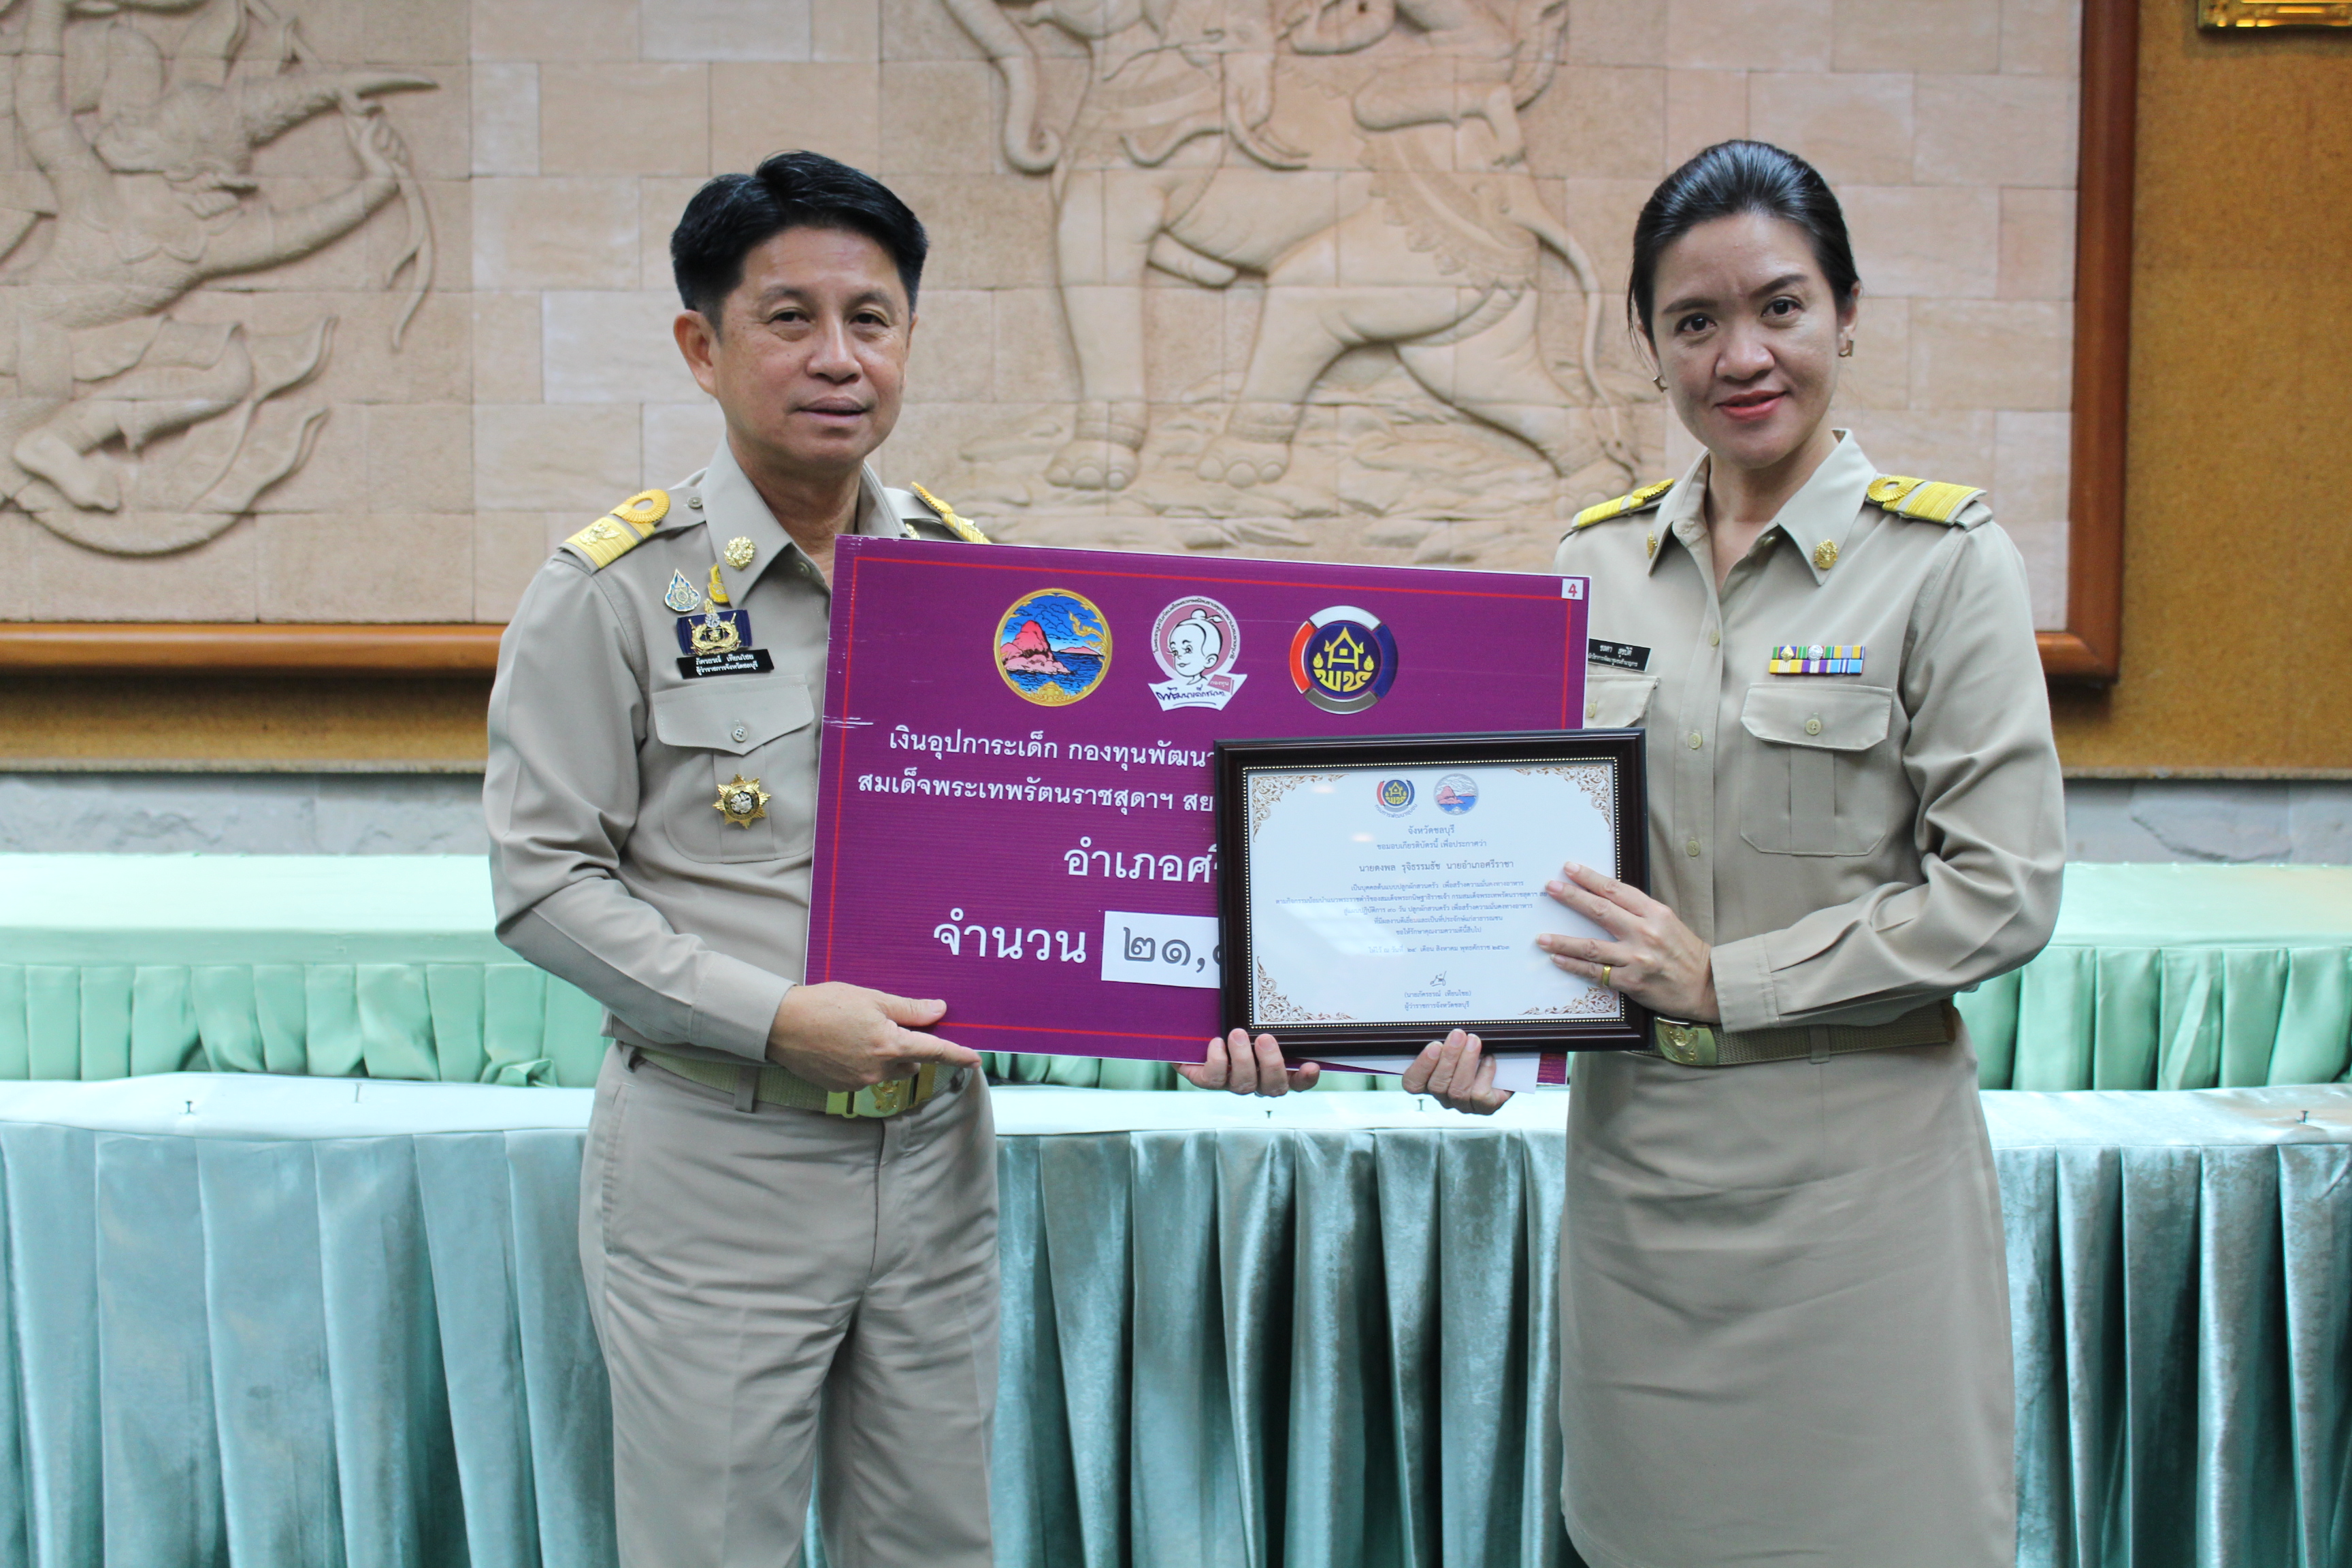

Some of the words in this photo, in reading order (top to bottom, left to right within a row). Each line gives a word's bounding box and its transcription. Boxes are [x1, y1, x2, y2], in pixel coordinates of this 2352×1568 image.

[1567, 583, 1578, 598] 4
[889, 725, 1058, 760] เงินอุปการะเด็ก
[858, 767, 1173, 815] สมเด็จพระเทพรัตนราชสุดาฯ
[1407, 824, 1455, 837] จังหวัดชลบุรี
[1377, 838, 1439, 851] ขอมอบเกียรติบัตรนี้
[1441, 838, 1487, 849] เพื่อประกาศว่า
[1064, 836, 1217, 883] อำเภอศ
[1446, 859, 1514, 870] นายอำเภอศรีราชา
[933, 907, 1087, 964] จำนวน
[1404, 1000, 1470, 1011] ผู้ว่าราชการจังหวัดชลบุรี
